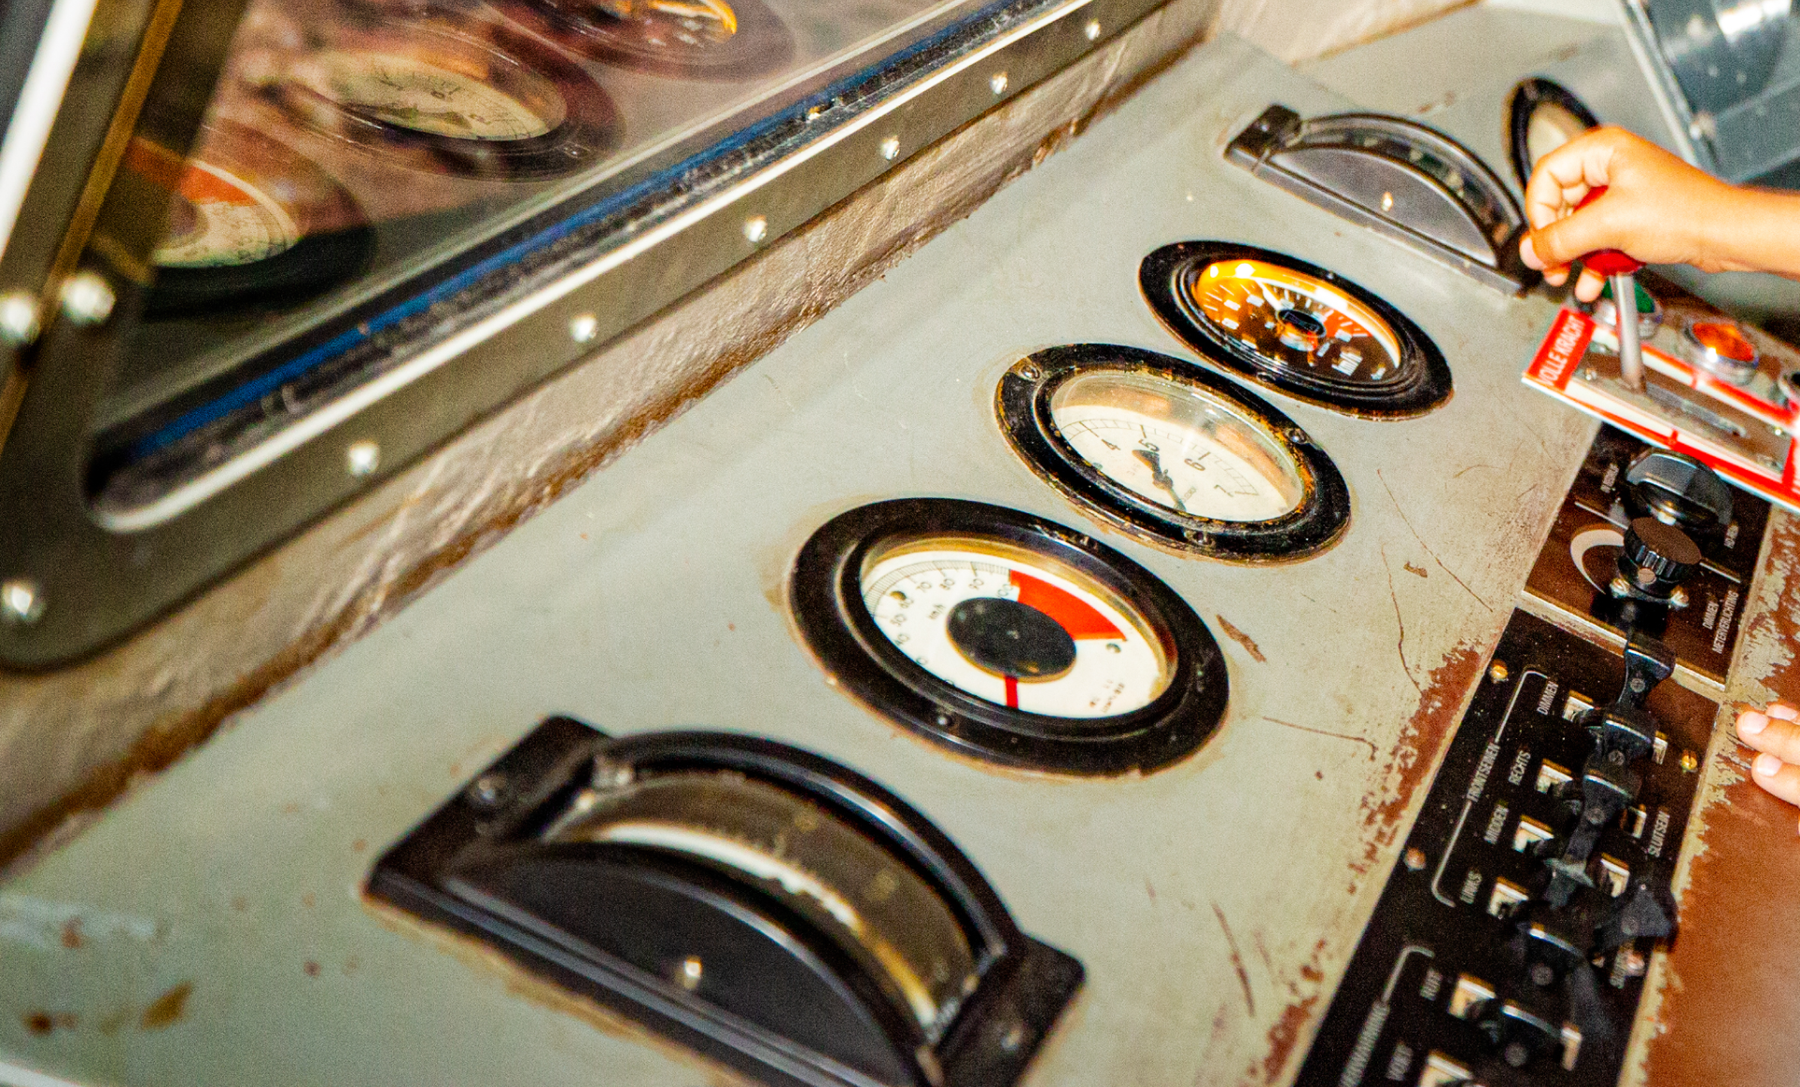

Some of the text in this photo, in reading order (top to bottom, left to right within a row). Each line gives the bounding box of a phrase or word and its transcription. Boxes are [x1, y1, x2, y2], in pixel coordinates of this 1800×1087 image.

[1536, 314, 1586, 386] VOLLE KRACHT
[1101, 438, 1122, 451] 4
[1138, 438, 1160, 453] 5
[1183, 457, 1206, 472] 6
[916, 581, 932, 593] 70
[968, 578, 984, 590] 90
[1703, 600, 1719, 630] DIMMEN
[1712, 589, 1739, 654] METERVERLICHTING
[1536, 681, 1559, 715] DIMMEN
[1466, 742, 1500, 802] FRONTSEINEN
[1508, 749, 1531, 786] RECHTS
[1484, 804, 1509, 845] MIDDEN
[1649, 811, 1670, 857] SLUITSEIN
[1461, 870, 1483, 904] LINKS
